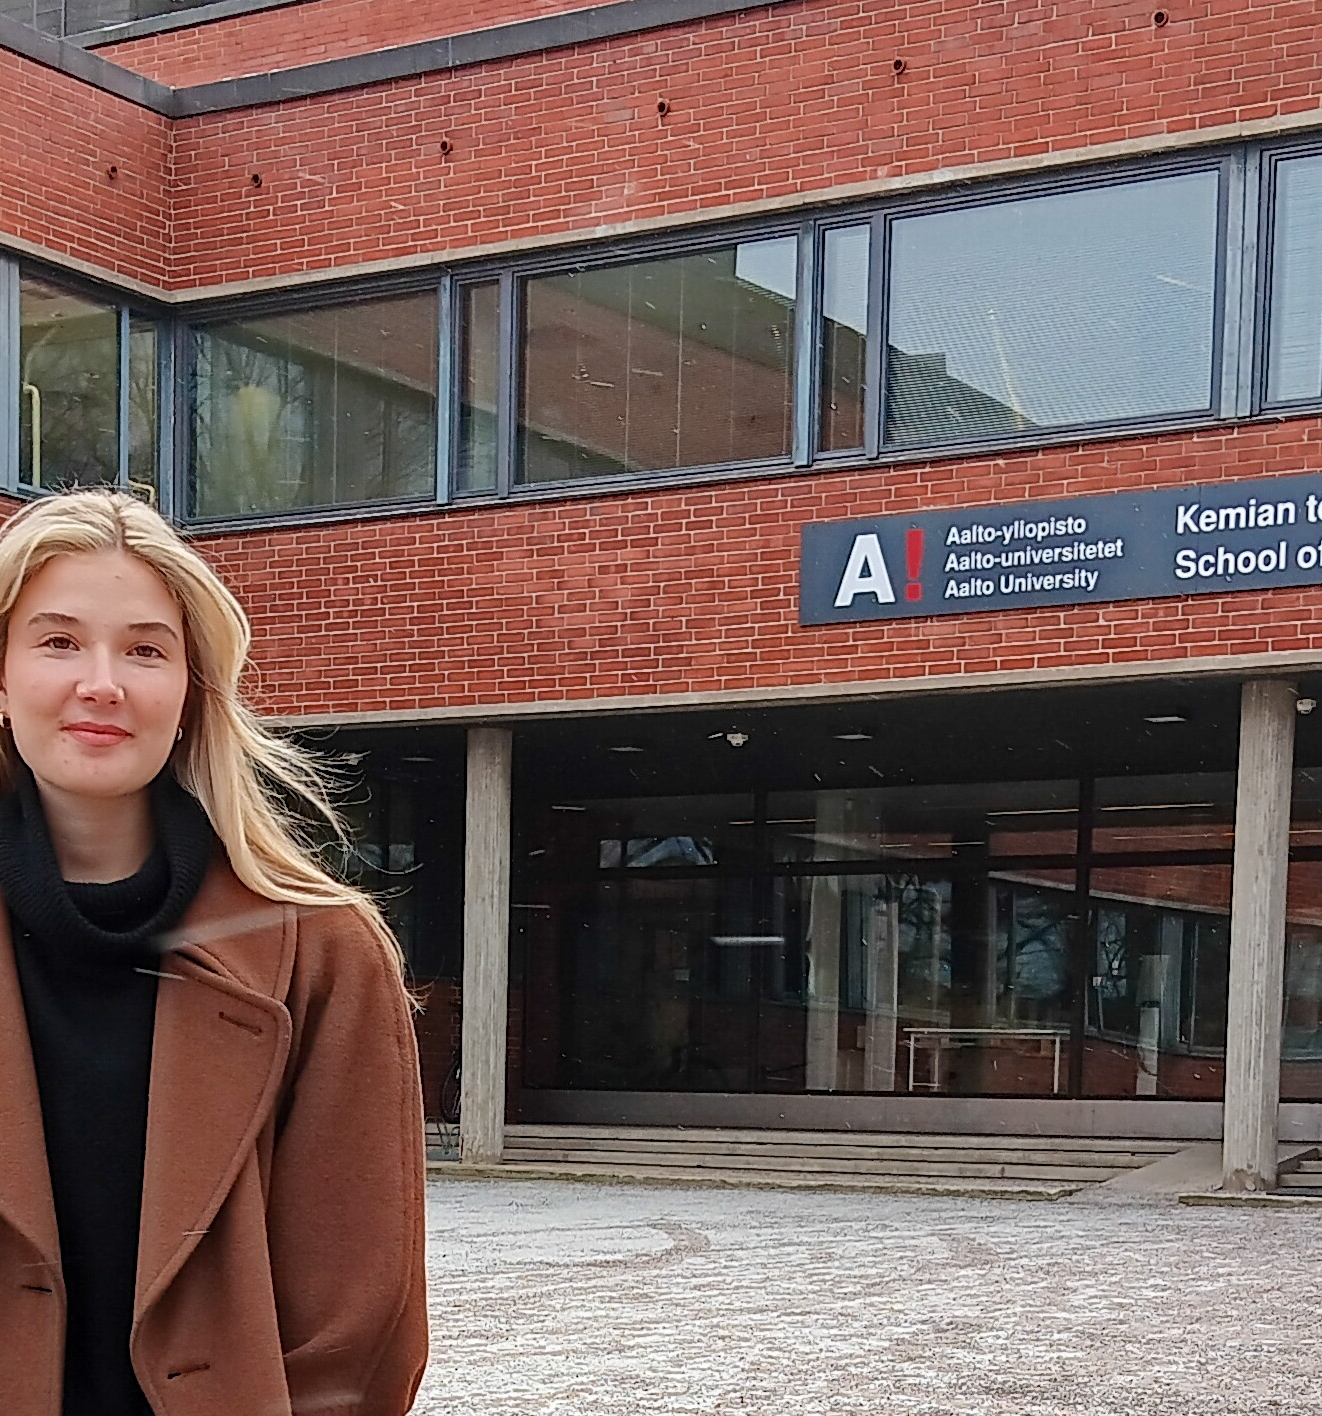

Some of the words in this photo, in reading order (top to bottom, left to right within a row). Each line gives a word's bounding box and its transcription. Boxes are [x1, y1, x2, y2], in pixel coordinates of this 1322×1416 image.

[945, 516, 1087, 545] Aalto-yliopisto
[1175, 498, 1296, 534] Kemian
[944, 538, 1125, 572] Aalto-universitetet
[1174, 541, 1287, 579] School
[944, 577, 995, 599] Aalto
[999, 569, 1099, 594] University
